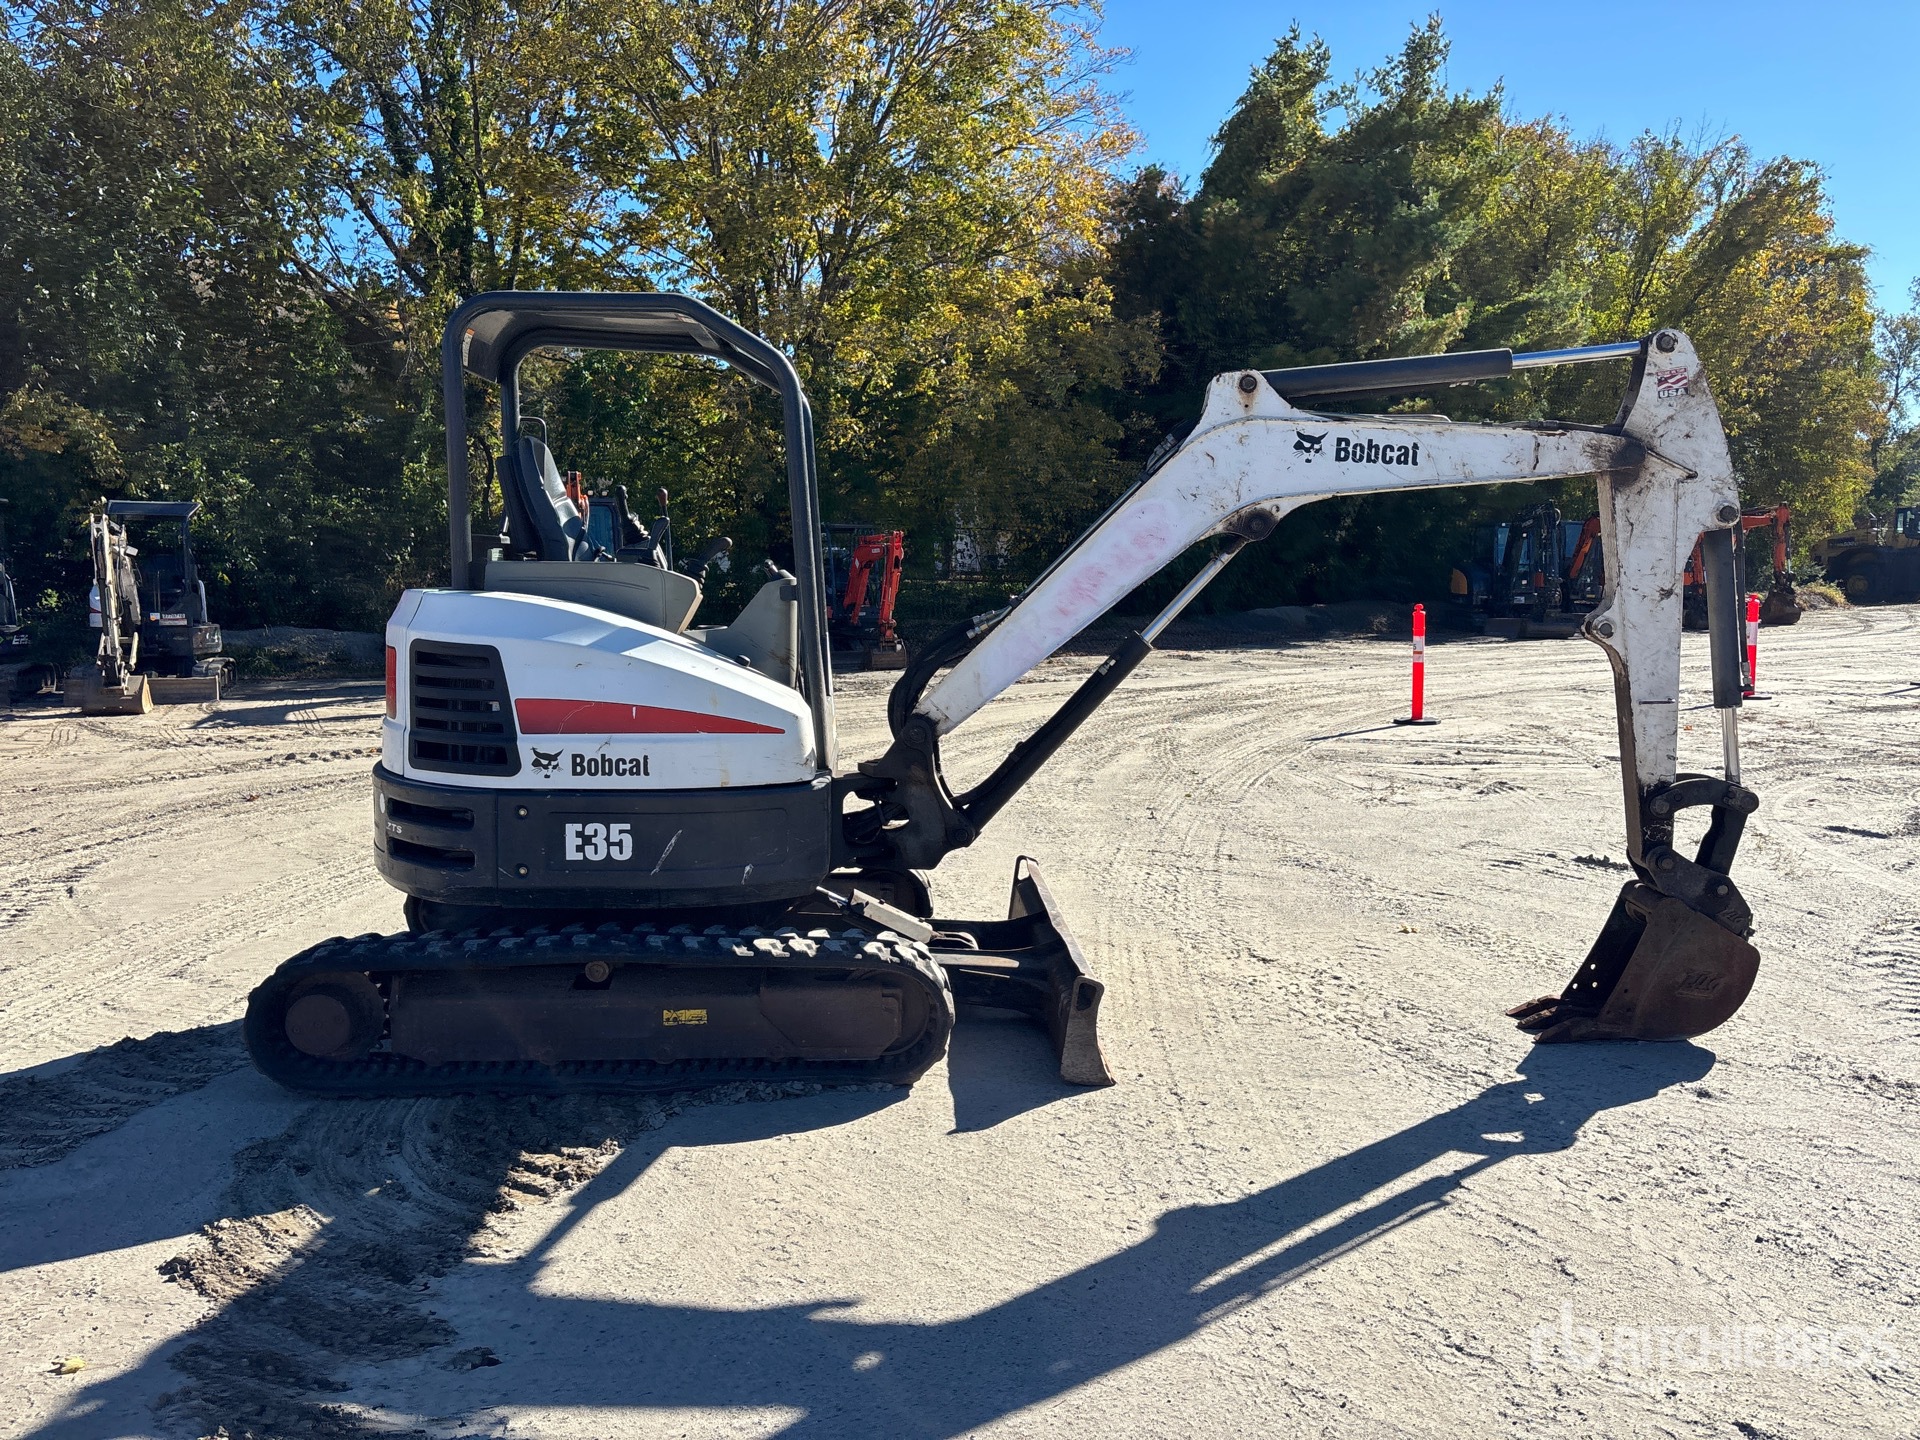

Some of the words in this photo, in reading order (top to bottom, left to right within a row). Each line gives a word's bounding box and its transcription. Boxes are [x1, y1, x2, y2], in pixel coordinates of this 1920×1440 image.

[1659, 387, 1687, 399] USA
[1335, 437, 1419, 466] Bobcat
[571, 753, 650, 777] Bobcat
[386, 821, 402, 834] ZTS
[565, 822, 633, 862] E35
